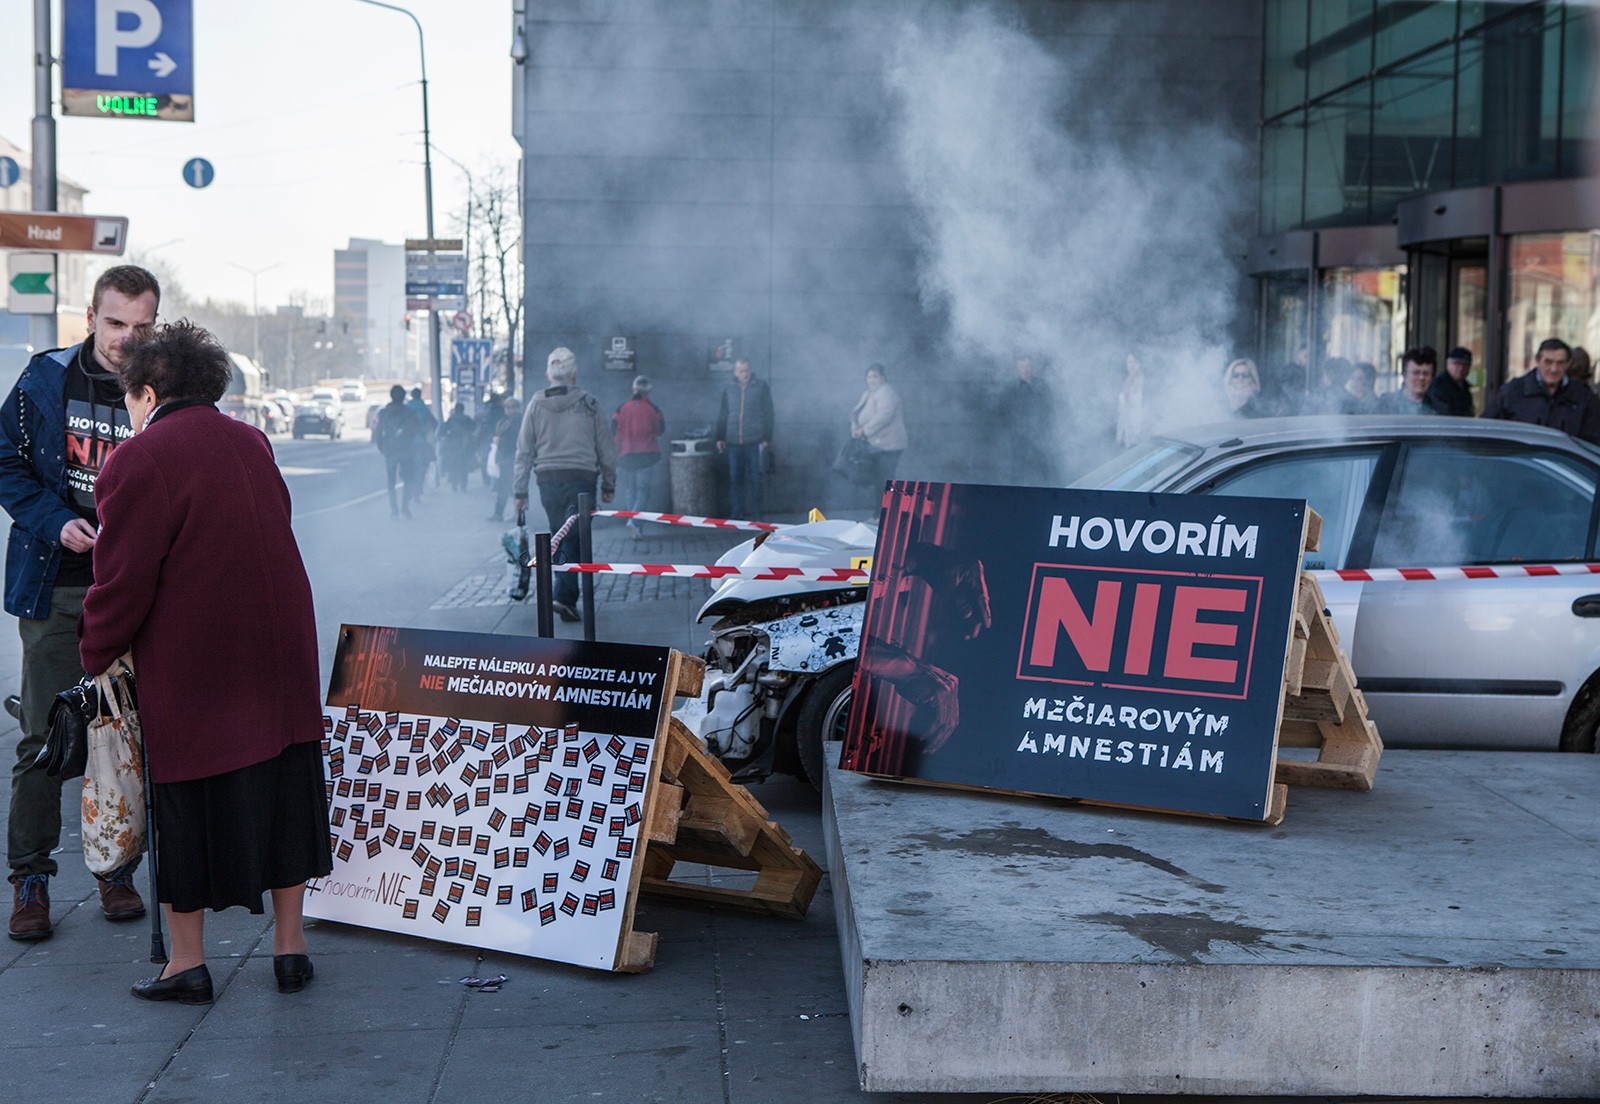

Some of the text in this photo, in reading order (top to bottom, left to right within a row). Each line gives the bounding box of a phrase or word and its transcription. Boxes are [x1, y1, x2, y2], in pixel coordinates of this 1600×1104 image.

[95, 0, 162, 76] P
[27, 224, 62, 241] Hrad
[1048, 514, 1259, 559] HOVORÍM
[1029, 576, 1248, 683] NIE
[423, 654, 657, 686] NALEPTE NÁLEPKU A POVEDZTE AJ VY
[419, 674, 653, 710] NIE MEČIAROVÝM AMNESTIÁM
[1022, 695, 1230, 737] MEČIAROVÝM
[1016, 730, 1225, 774] AMNESTIÁM
